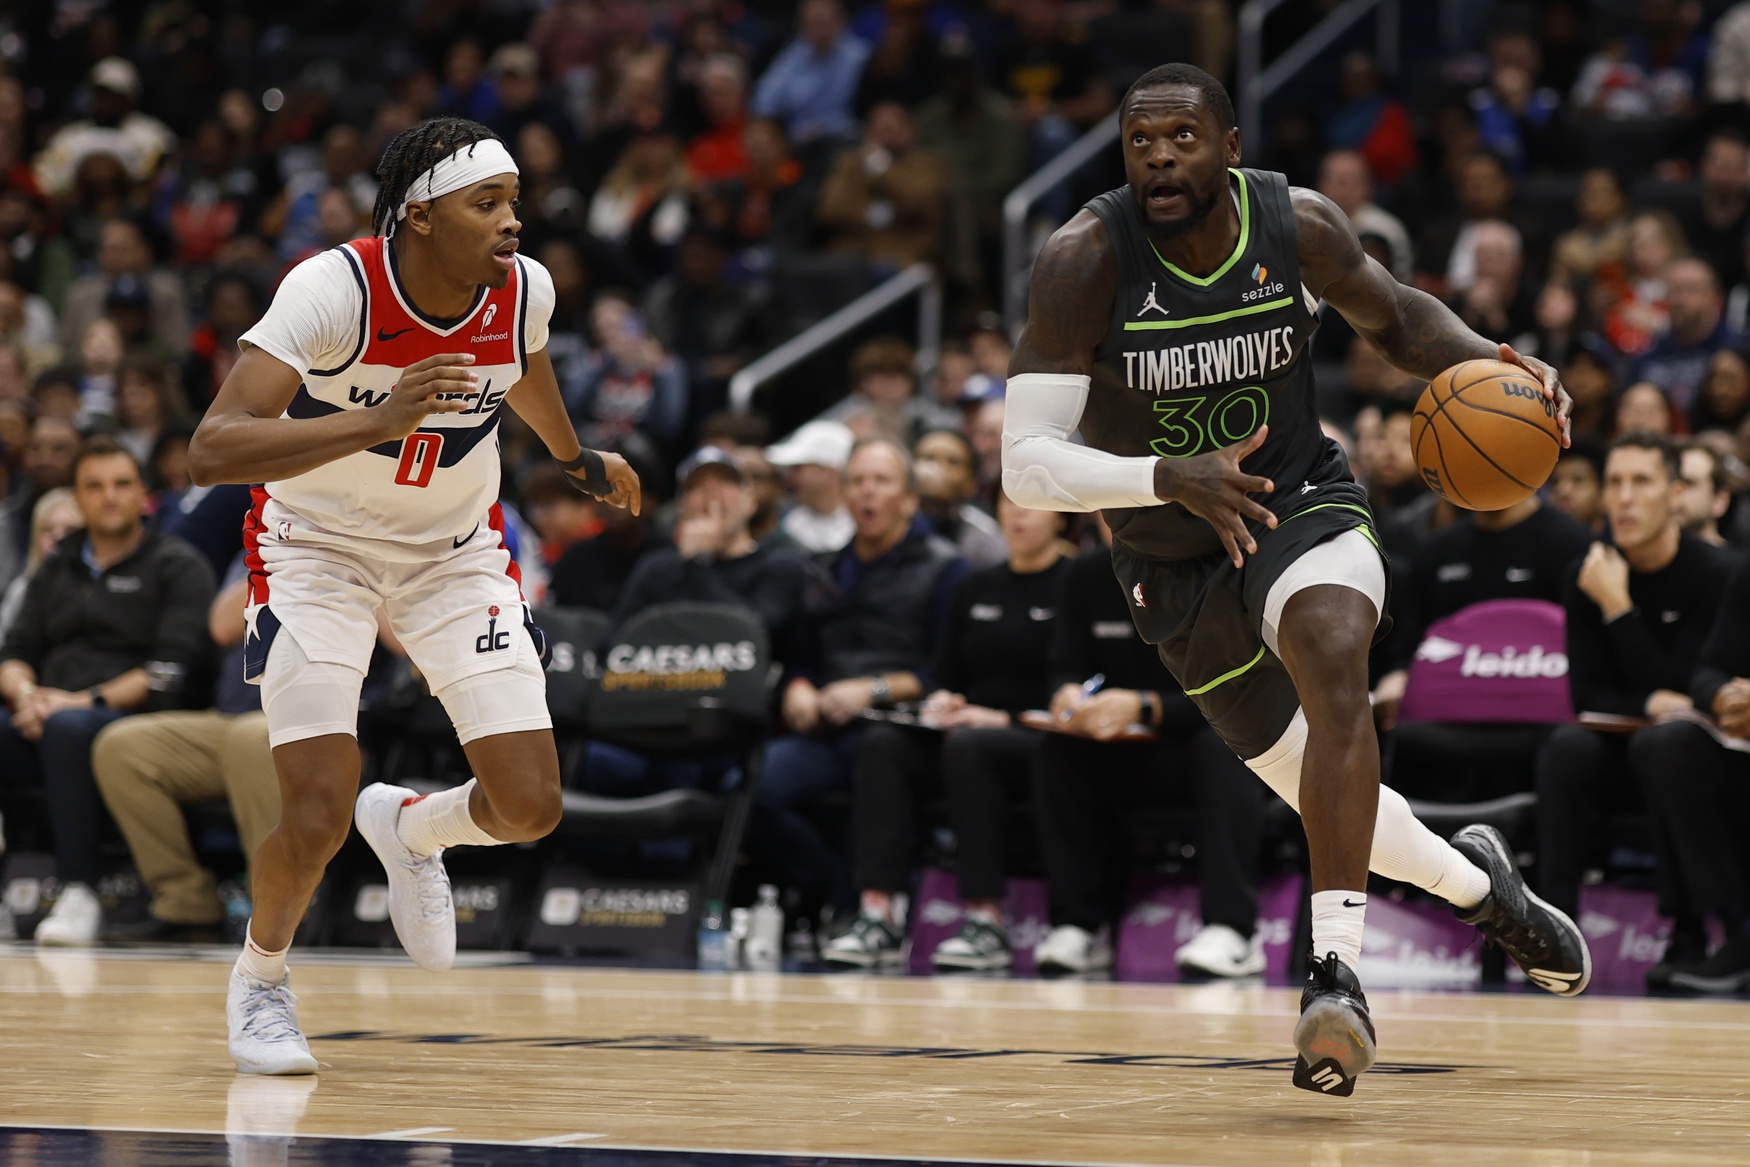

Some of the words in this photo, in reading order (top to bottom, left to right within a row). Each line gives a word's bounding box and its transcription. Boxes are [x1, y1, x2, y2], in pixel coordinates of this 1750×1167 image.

[1241, 281, 1285, 303] sezzle
[470, 331, 509, 344] Robinhood
[1122, 325, 1294, 397] TIMBERWOLVES
[1149, 386, 1270, 458] 30
[394, 432, 444, 488] 0
[606, 641, 757, 675] CAESARS
[1460, 644, 1570, 678] leido
